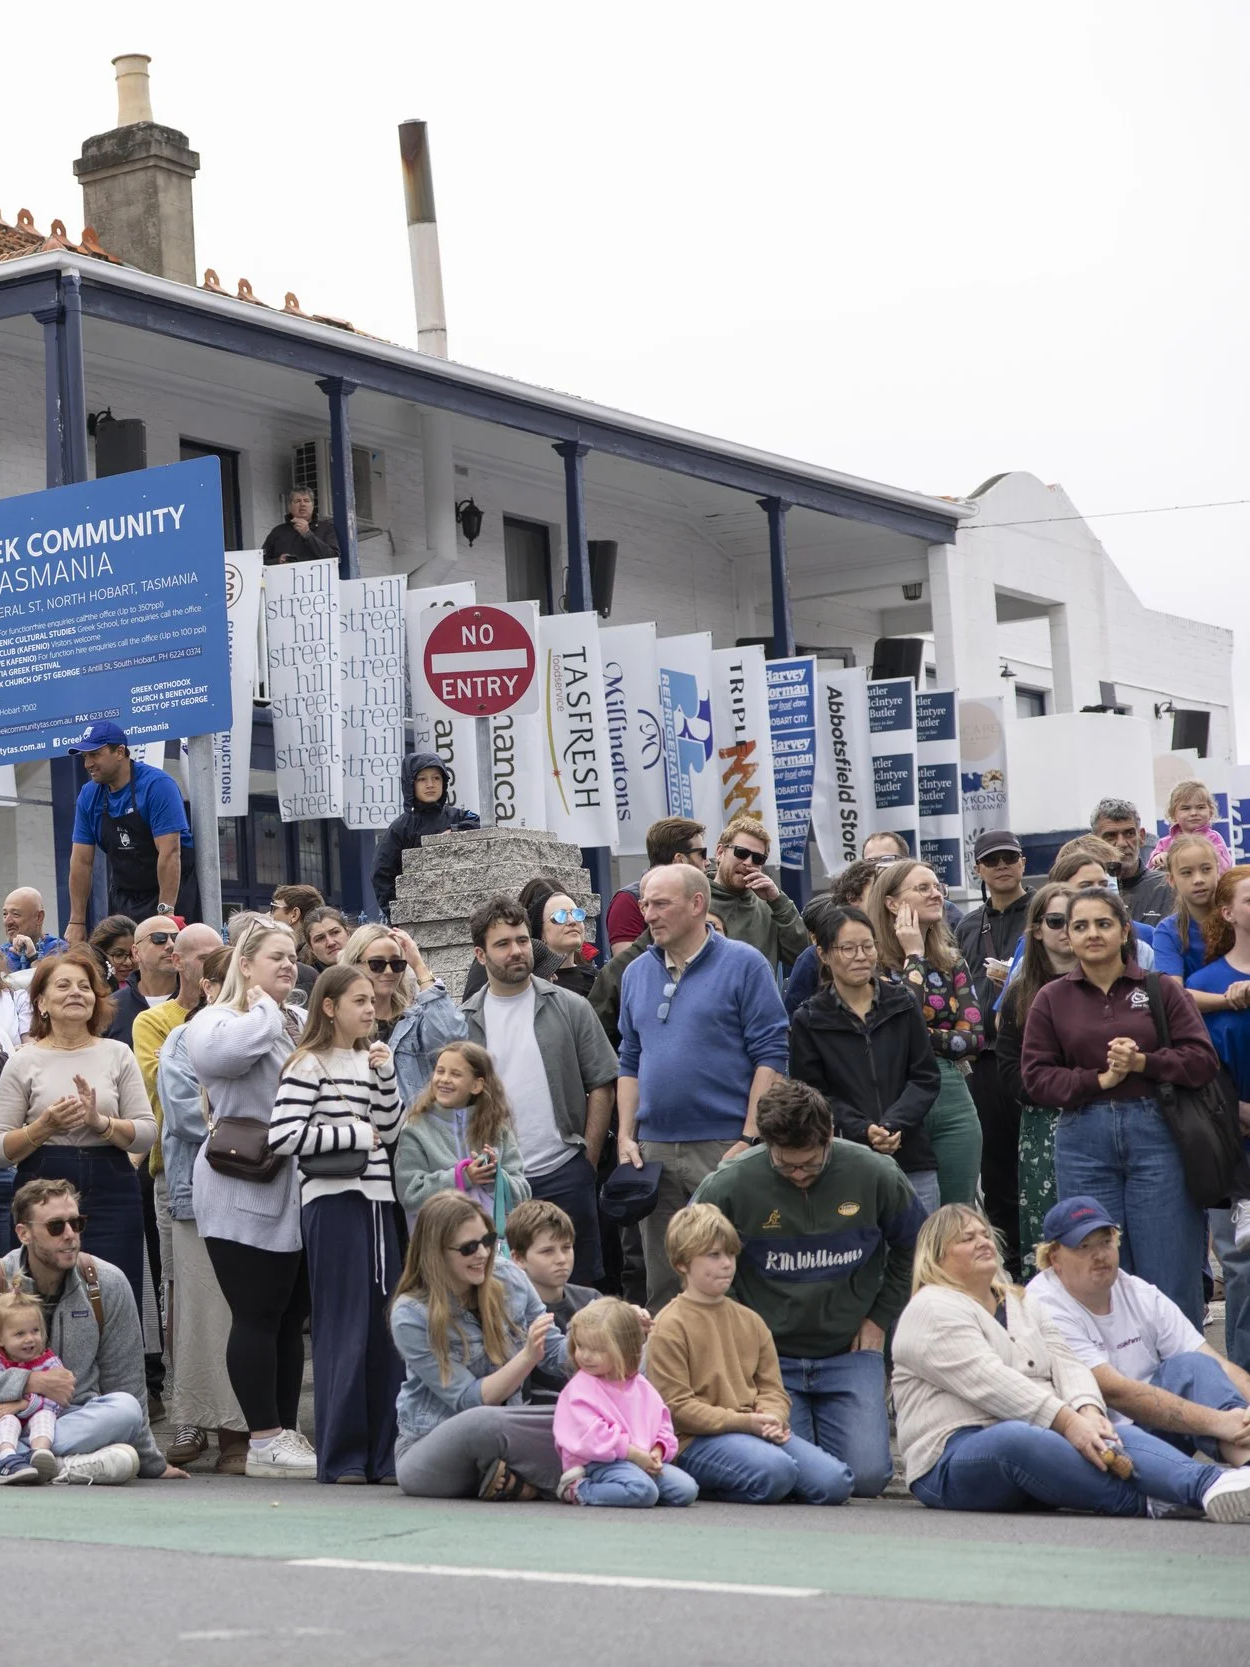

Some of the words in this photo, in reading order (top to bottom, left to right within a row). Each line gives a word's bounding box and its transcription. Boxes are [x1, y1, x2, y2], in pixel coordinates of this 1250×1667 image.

[27, 504, 185, 557] COMMUNITY
[28, 600, 44, 613] ST,
[47, 592, 86, 610] NORTH
[89, 583, 138, 602] HOBART,
[141, 572, 198, 592] TASMANIA
[291, 564, 330, 594] hill
[268, 592, 337, 620] street
[362, 580, 400, 609] hill
[15, 632, 48, 644] CULTURAL
[49, 627, 76, 638] STUDIES
[77, 624, 96, 633] Greek
[97, 619, 119, 630] School,
[130, 613, 159, 624] enquiries
[160, 610, 171, 619] call
[172, 608, 183, 616] the
[184, 605, 202, 614] office
[292, 613, 330, 643] hill
[462, 624, 494, 646] NO
[0, 648, 16, 657] CLUB
[17, 642, 50, 654] (KAFENIO)
[51, 640, 73, 648] Visitors
[73, 634, 101, 644] welcome
[6, 655, 37, 666] KAFENIO)
[49, 649, 75, 659] function
[88, 642, 117, 652] enquiries
[118, 638, 129, 647] call
[129, 637, 140, 645] the
[141, 634, 159, 643] office
[159, 632, 171, 641] (Up
[181, 627, 193, 636] 100
[194, 625, 207, 635] ppl)
[270, 642, 338, 668] street
[363, 627, 401, 656] hill
[5, 676, 32, 687] CHURCH
[32, 674, 42, 683] OF
[43, 673, 52, 681] ST
[53, 668, 80, 679] GEORGE
[113, 659, 133, 669] South
[169, 650, 185, 659] 6224
[186, 647, 201, 656] 0374
[8, 666, 30, 676] GREEK
[31, 661, 61, 672] FESTIVAL
[294, 664, 332, 694] hill
[131, 685, 152, 695] GREEK
[154, 678, 191, 691] ORTHODOX
[131, 694, 158, 704] CHURCH
[165, 685, 208, 699] BENEVOLENT
[363, 677, 402, 706] hill
[442, 675, 518, 700] ENTRY
[552, 654, 564, 712] foodservice
[0, 706, 20, 716] Hobart
[75, 714, 89, 723] FAX
[132, 703, 159, 714] SOCIETY
[160, 701, 170, 709] OF
[171, 700, 179, 708] ST
[180, 695, 208, 706] GEORGE
[273, 692, 339, 718] street
[870, 708, 896, 718] Butler
[296, 714, 332, 744] hill
[562, 646, 600, 809] TASFRESH
[794, 714, 808, 724] CITY
[602, 662, 631, 822] Millingtons
[277, 744, 340, 769] street
[299, 766, 330, 794] hill
[826, 685, 854, 804] Abbotsfield
[840, 809, 858, 862] Store
[876, 782, 902, 792] Butler
[282, 793, 338, 817] street
[681, 772, 692, 810] RBR
[766, 1248, 862, 1271] R.M.Williams
